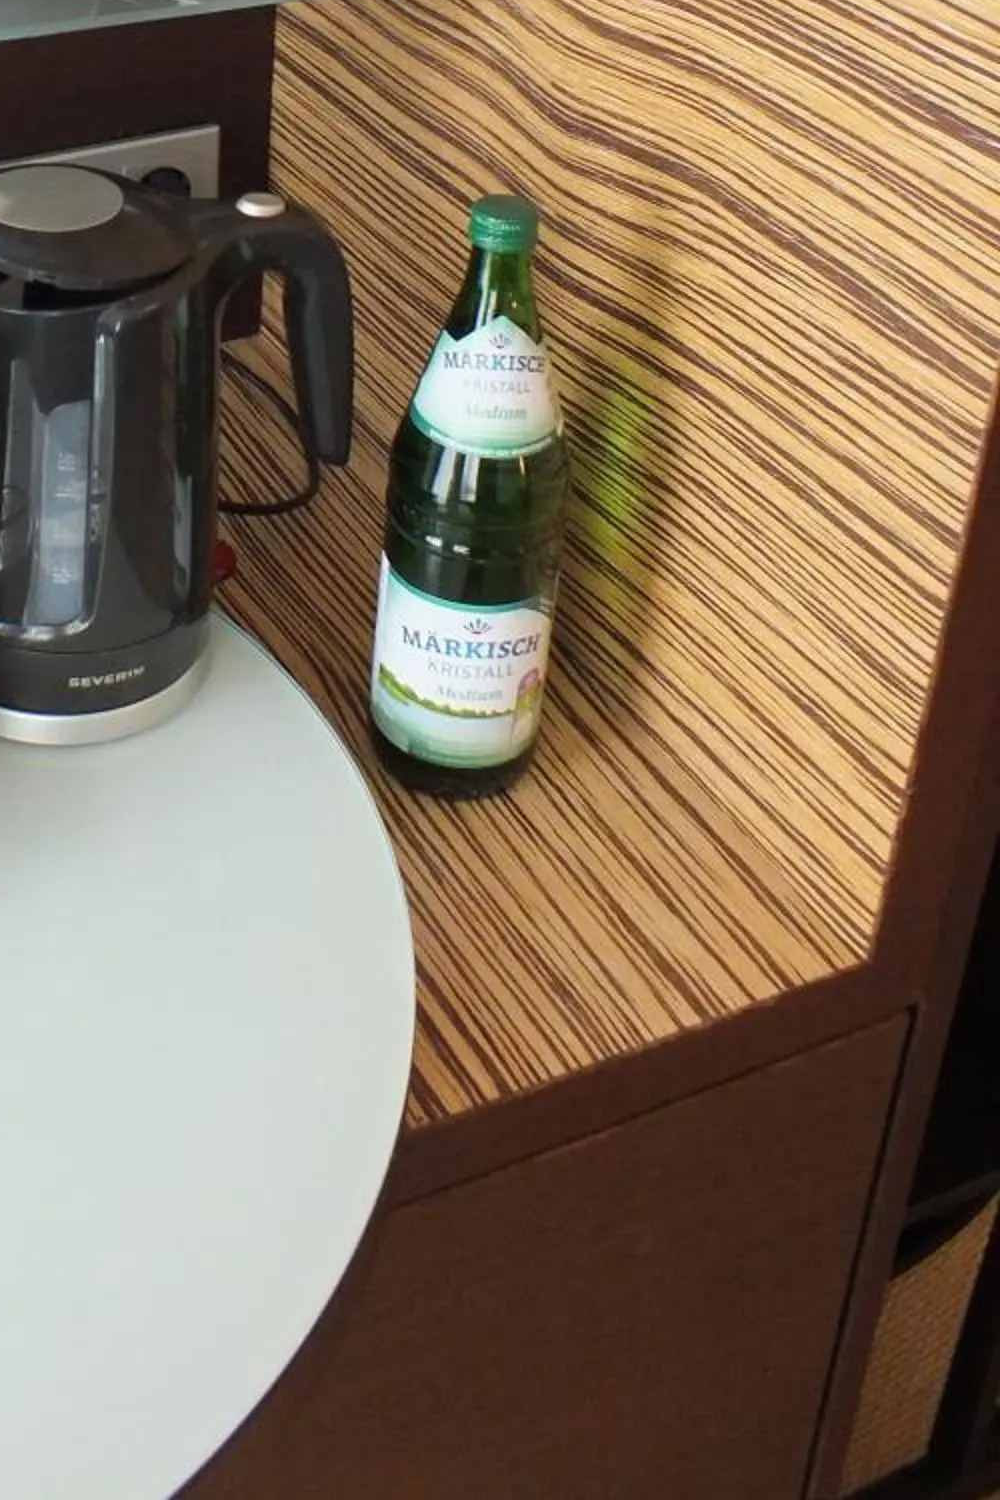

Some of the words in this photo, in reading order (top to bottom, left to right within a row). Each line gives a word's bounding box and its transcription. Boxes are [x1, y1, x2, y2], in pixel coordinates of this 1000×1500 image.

[401, 625, 541, 659] MÄRKISCH
[69, 665, 145, 688] SEVERIN
[427, 656, 515, 680] KRISTALL
